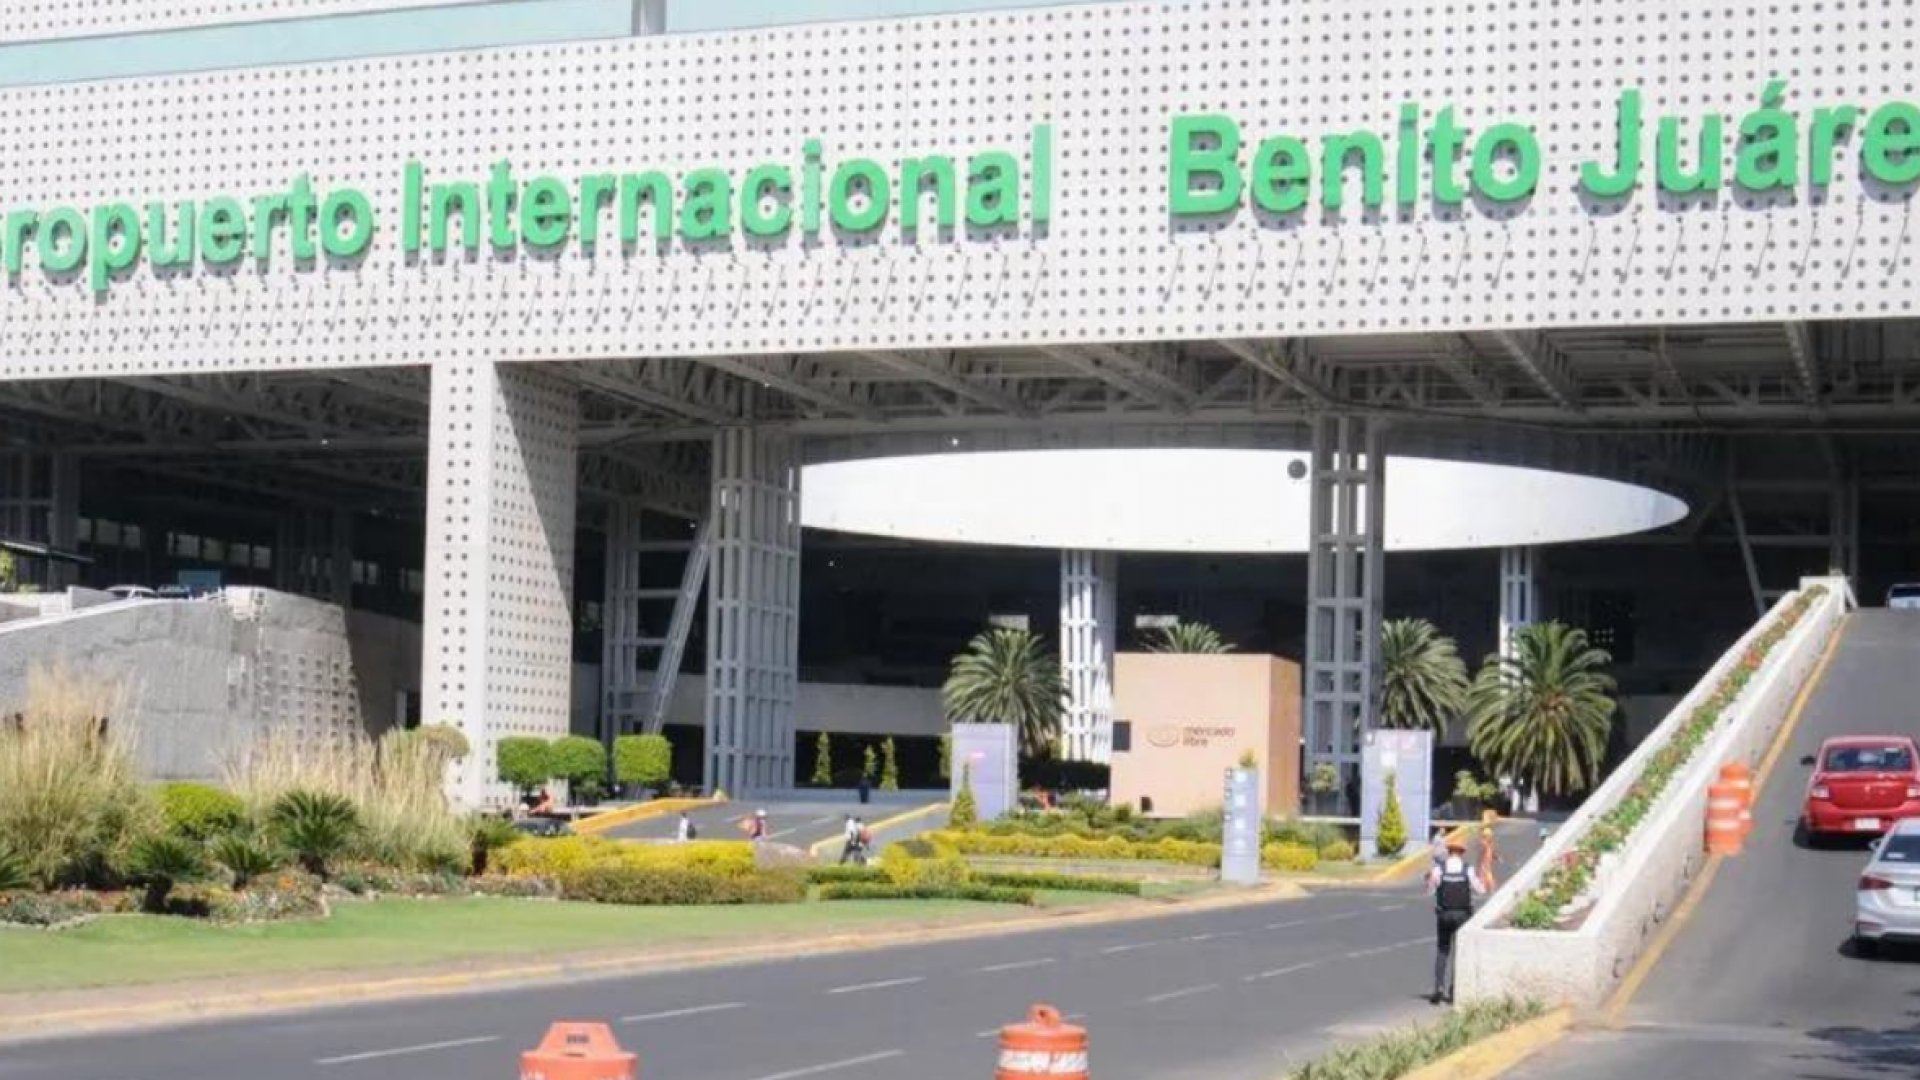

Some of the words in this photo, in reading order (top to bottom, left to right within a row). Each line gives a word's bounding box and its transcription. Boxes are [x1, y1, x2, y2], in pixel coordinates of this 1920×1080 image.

[402, 126, 1050, 251] Internacional
[1169, 104, 1543, 216] Benito
[1581, 80, 1920, 196] Juáre
